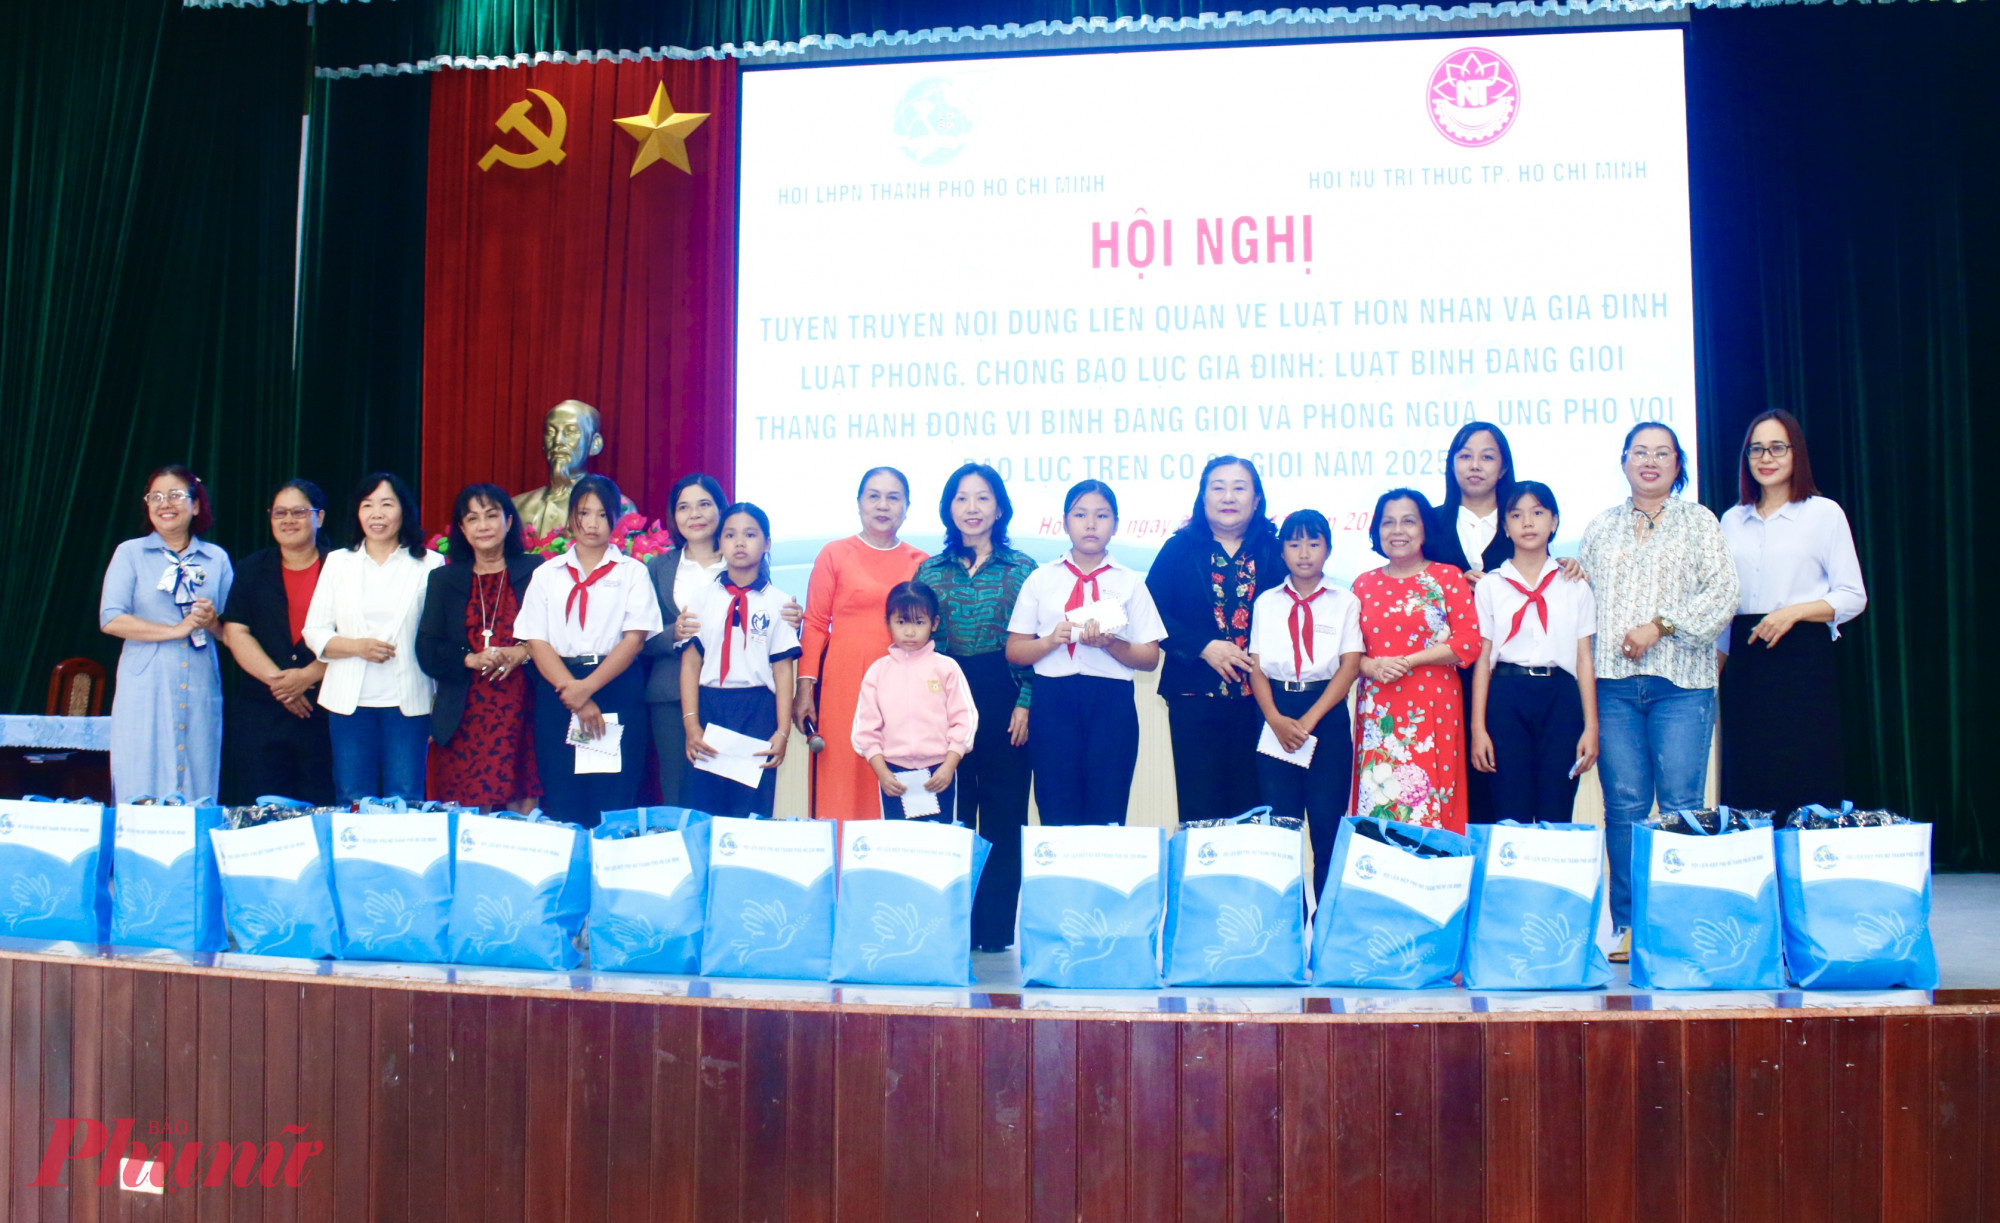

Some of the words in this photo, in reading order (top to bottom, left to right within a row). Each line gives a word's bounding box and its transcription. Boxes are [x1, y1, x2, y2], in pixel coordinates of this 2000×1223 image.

[1091, 206, 1173, 280] HỘI
[1196, 214, 1313, 275] NGHỊ
[1008, 307, 1078, 335] DUNG
[1155, 303, 1225, 334] QUAN
[1547, 293, 1592, 322] GIA
[1198, 354, 1241, 381] GIA
